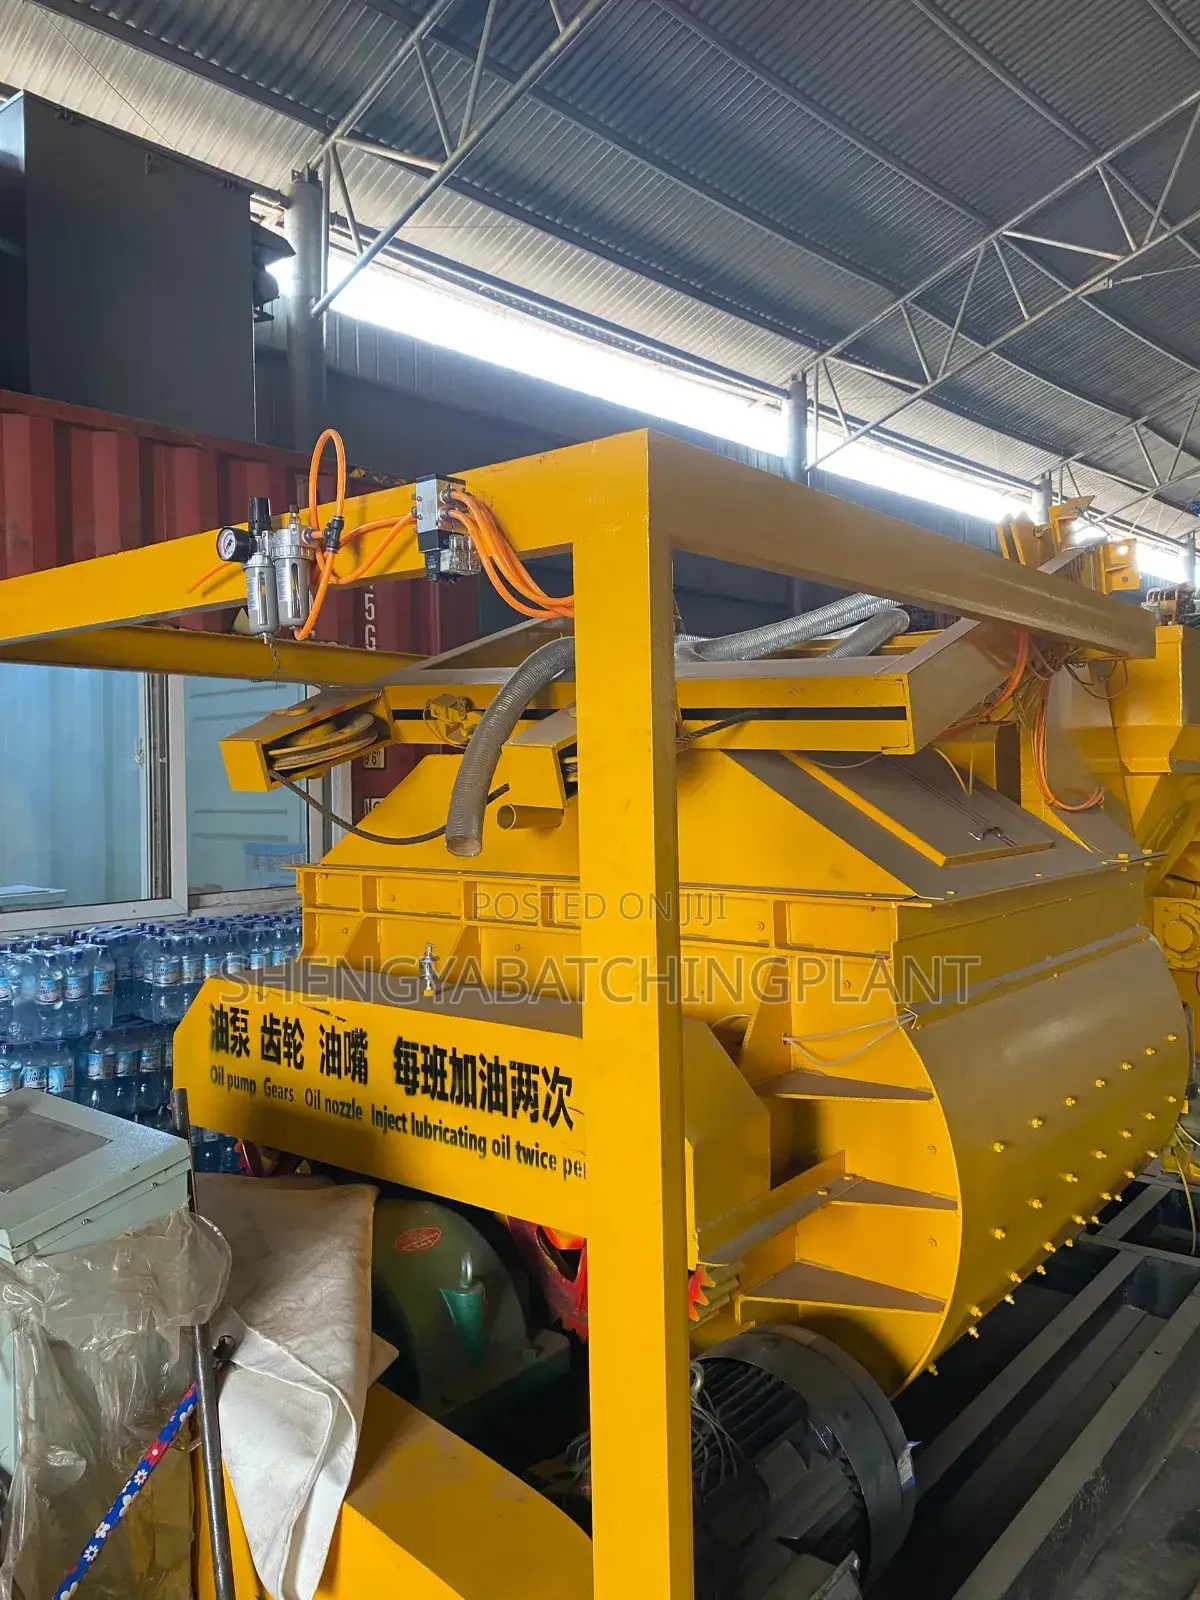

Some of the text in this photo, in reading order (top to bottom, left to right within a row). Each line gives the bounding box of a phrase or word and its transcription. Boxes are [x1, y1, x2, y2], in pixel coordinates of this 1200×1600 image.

[209, 1002, 574, 1132] 油泵 齿轮 油嘴 每班加油两次
[210, 1065, 225, 1086] Oil
[227, 1073, 257, 1095] pump
[263, 1077, 294, 1102] Gears
[304, 1087, 321, 1111] Oil
[325, 1097, 363, 1121] nozzle
[371, 1103, 408, 1134] Inject
[411, 1112, 487, 1159] lubricating
[491, 1134, 511, 1160] oil
[515, 1140, 557, 1171] twice
